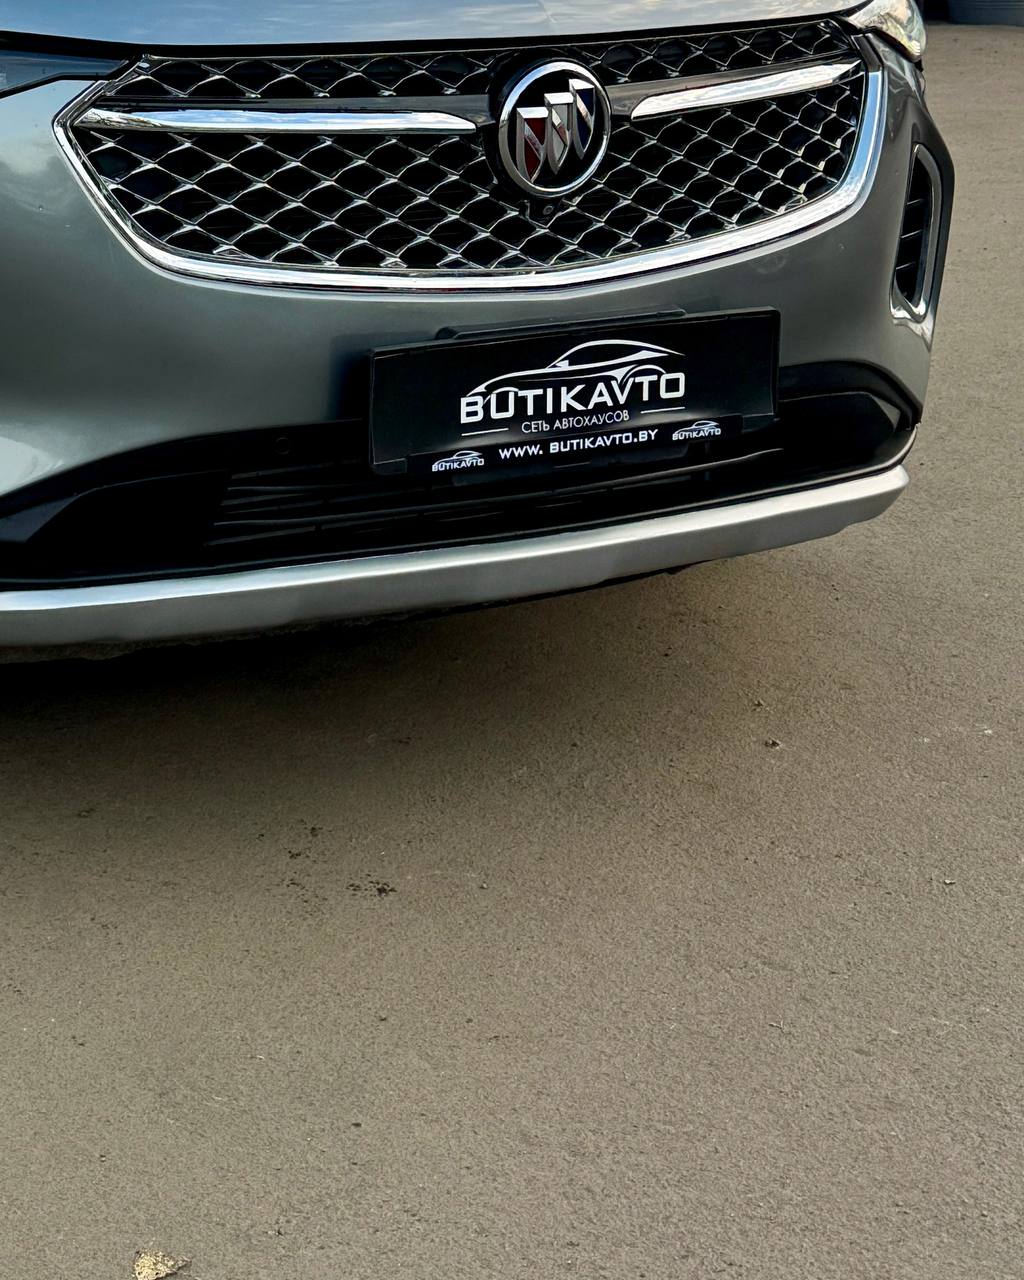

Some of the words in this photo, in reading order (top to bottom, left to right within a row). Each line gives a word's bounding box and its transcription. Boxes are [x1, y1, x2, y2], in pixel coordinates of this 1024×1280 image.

[460, 372, 686, 424] BUTIKAVTO
[521, 420, 550, 434] СЕТЬ
[553, 410, 630, 430] АВТОХАУСОВ
[672, 427, 722, 441] BUTIKAVTO
[549, 429, 659, 453] BUTIKAVTO.BY
[431, 458, 485, 472] BUTIKAVTO
